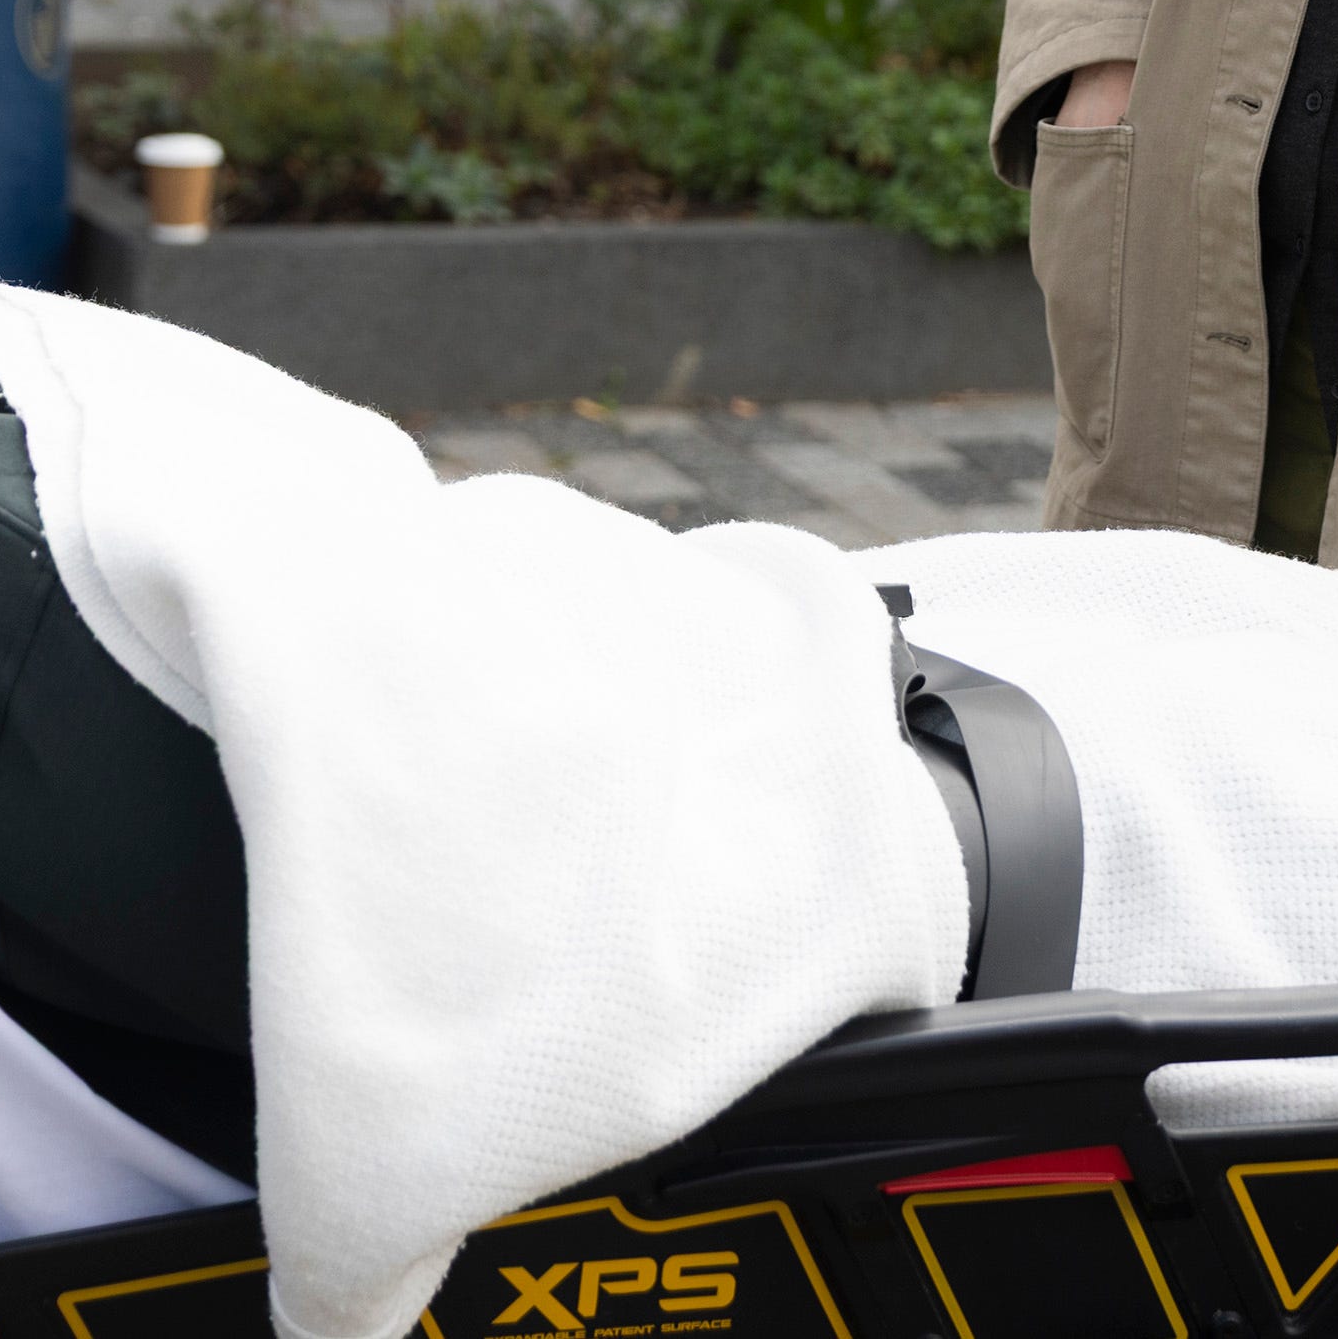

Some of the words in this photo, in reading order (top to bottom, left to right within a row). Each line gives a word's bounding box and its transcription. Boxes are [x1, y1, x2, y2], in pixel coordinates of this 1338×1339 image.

[491, 1251, 739, 1330] XPS
[594, 1324, 654, 1338] PATIENT
[661, 1318, 732, 1332] SURFACE
